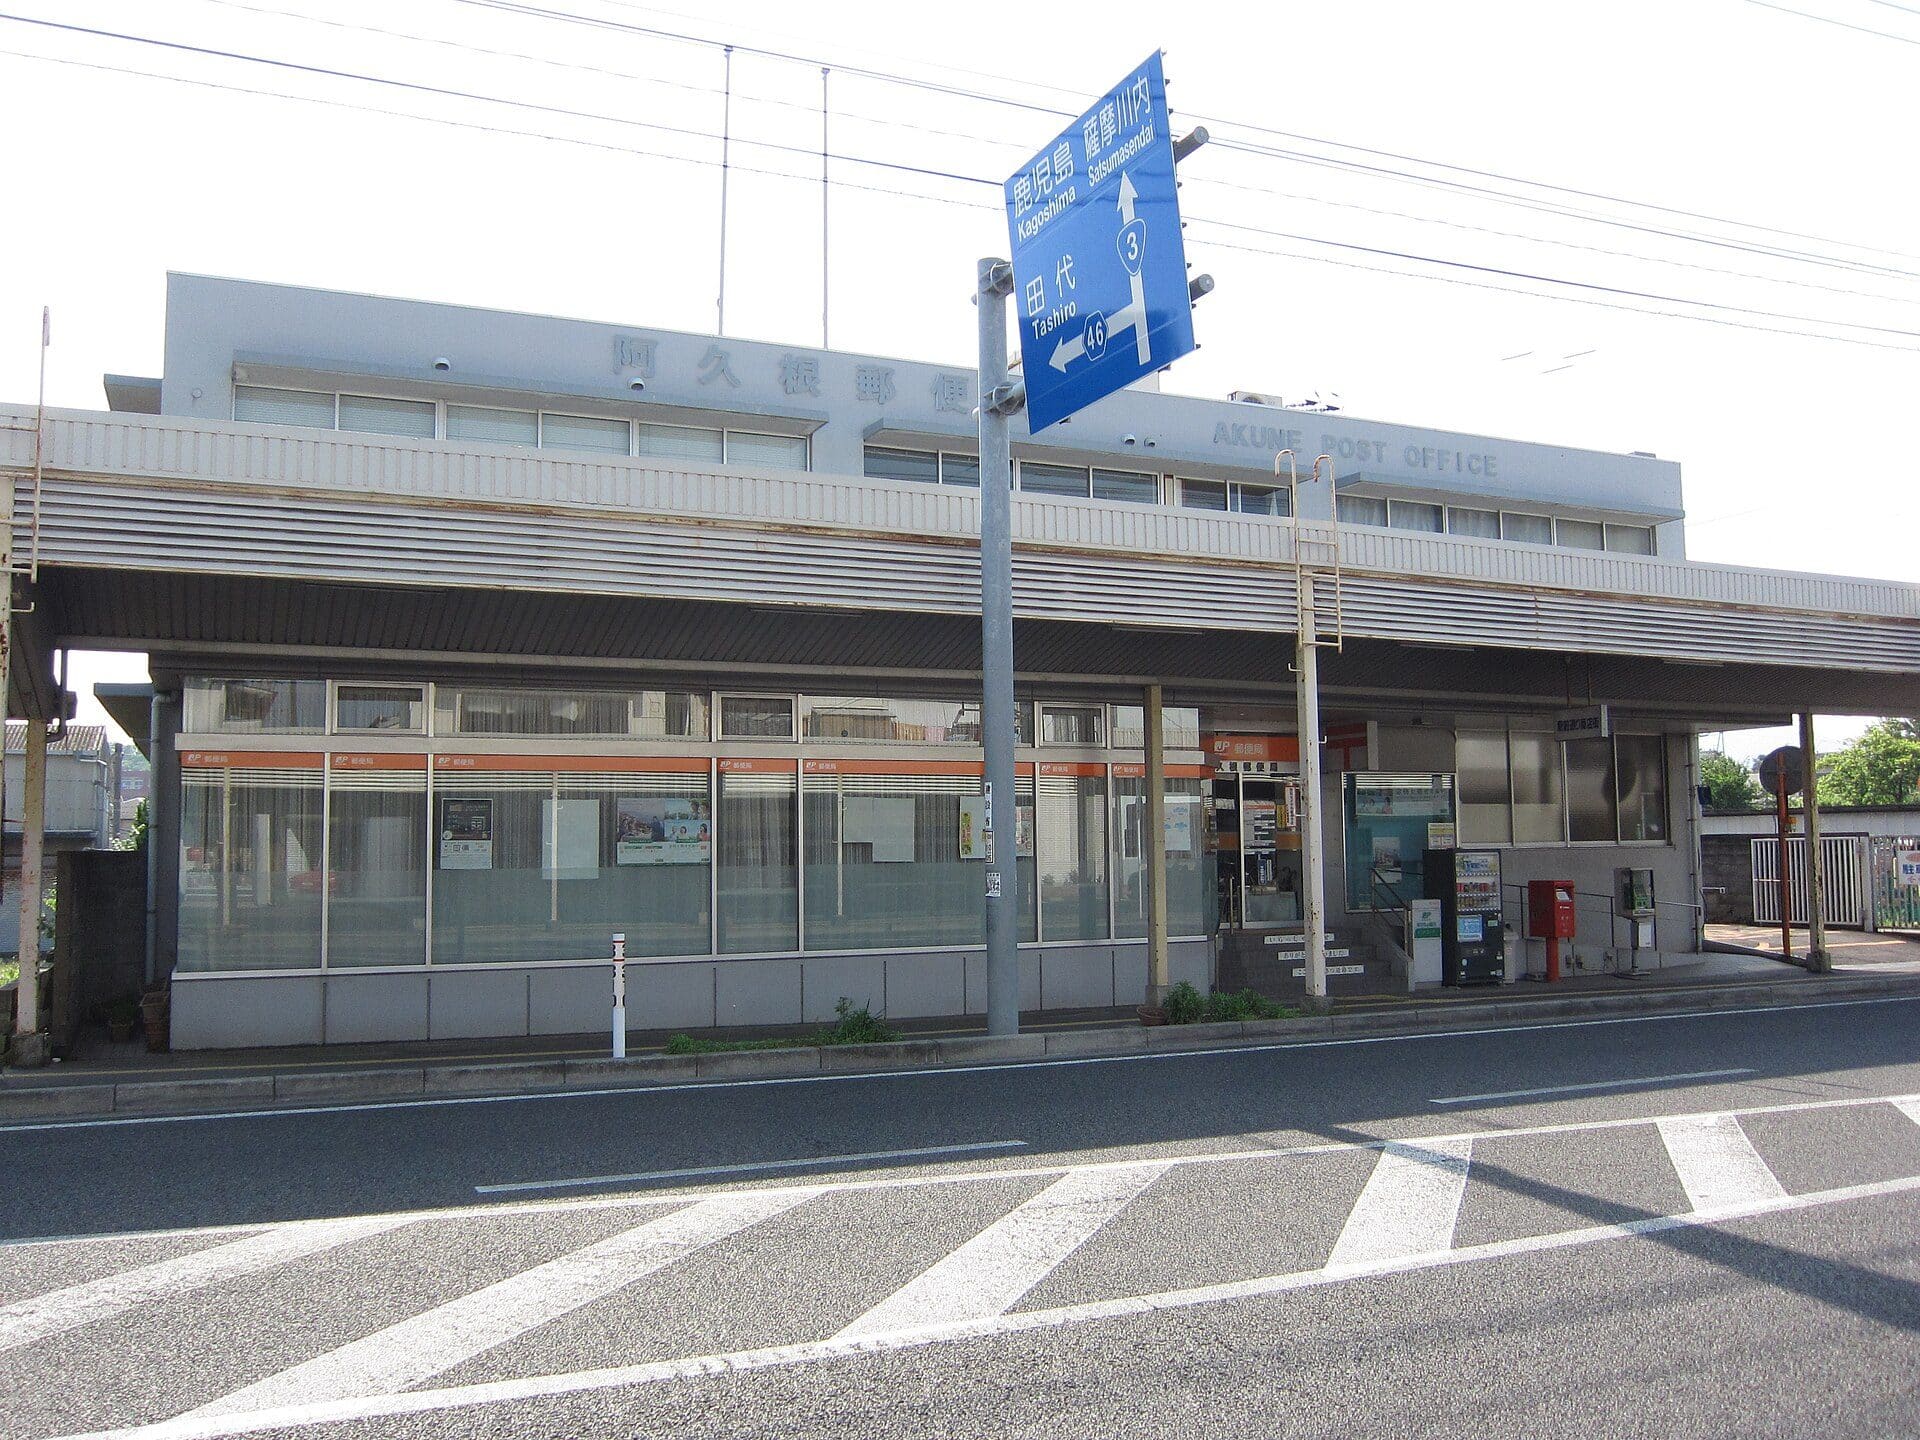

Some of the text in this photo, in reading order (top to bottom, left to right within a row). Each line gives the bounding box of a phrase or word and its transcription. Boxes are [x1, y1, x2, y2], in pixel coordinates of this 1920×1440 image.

[1083, 75, 1150, 162] 薩摩川内
[1013, 141, 1074, 219] 鹿児島
[1088, 119, 1155, 187] Satsumasendai
[1017, 186, 1076, 242] Kagoshima
[1126, 231, 1138, 260] 3
[1026, 254, 1076, 317] 田代
[1032, 301, 1076, 340] Tashiro
[1087, 321, 1104, 350] 46
[1213, 421, 1498, 477] AKUNE POST OFFICE
[1234, 743, 1265, 754] 郵便局
